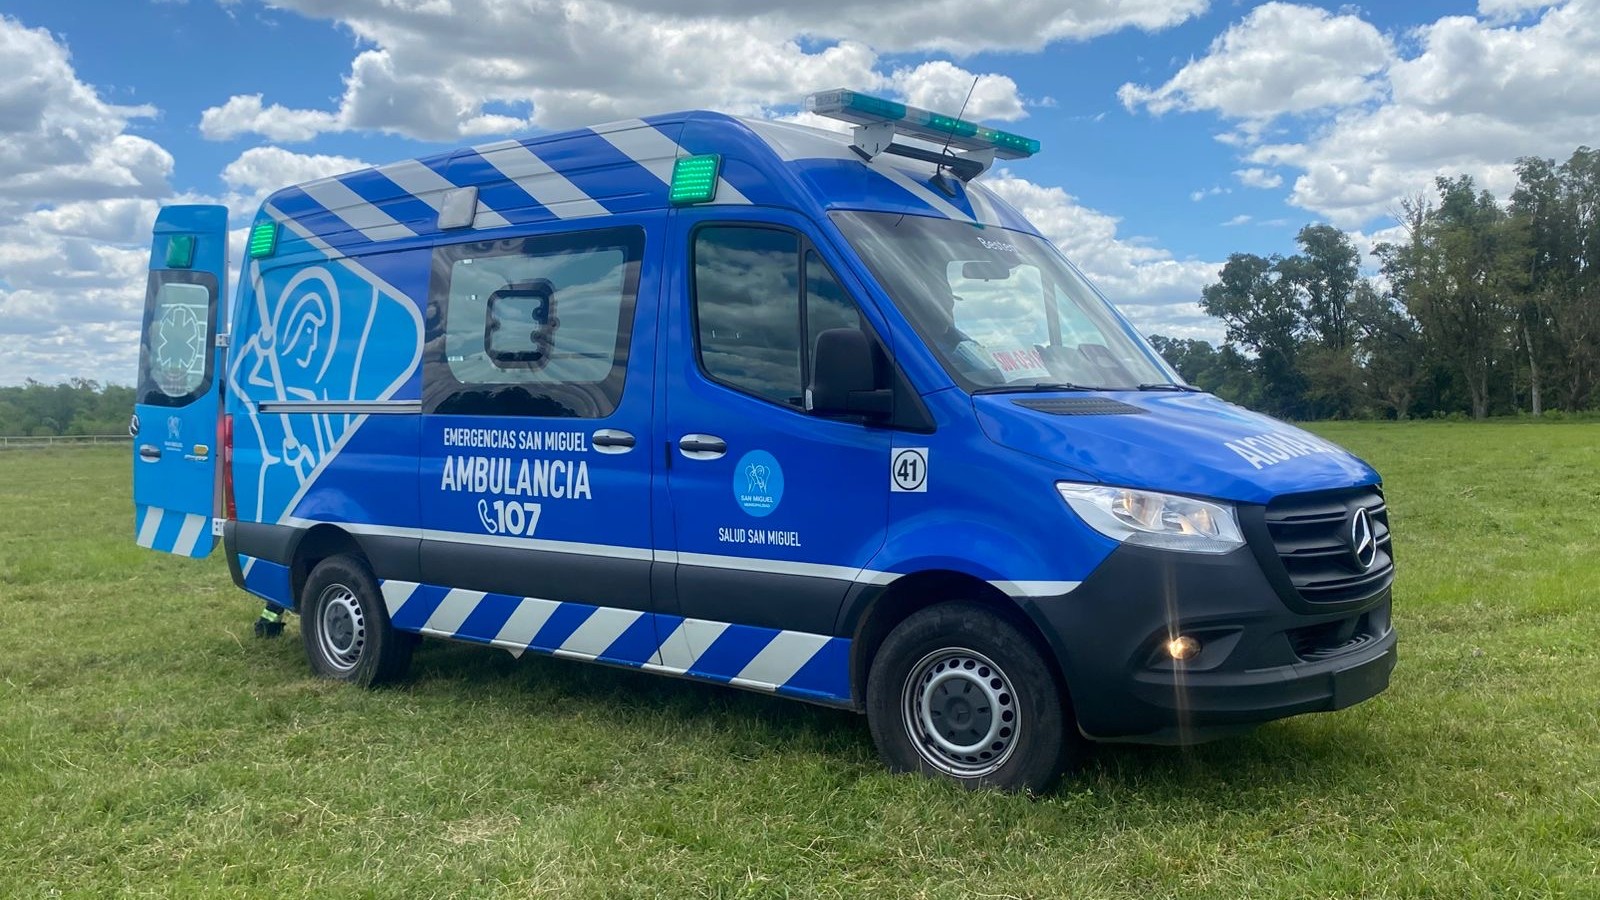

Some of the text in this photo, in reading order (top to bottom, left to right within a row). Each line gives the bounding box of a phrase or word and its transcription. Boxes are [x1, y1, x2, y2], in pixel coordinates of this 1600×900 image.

[443, 427, 588, 452] EMERGENCIAS SAN MIGUEL
[440, 454, 592, 500] AMBULANCIA
[897, 458, 917, 482] 41
[740, 494, 774, 503] SAN MIGUEL
[493, 499, 542, 536] 107
[718, 526, 802, 547] SALUD SAN MIGUEL
